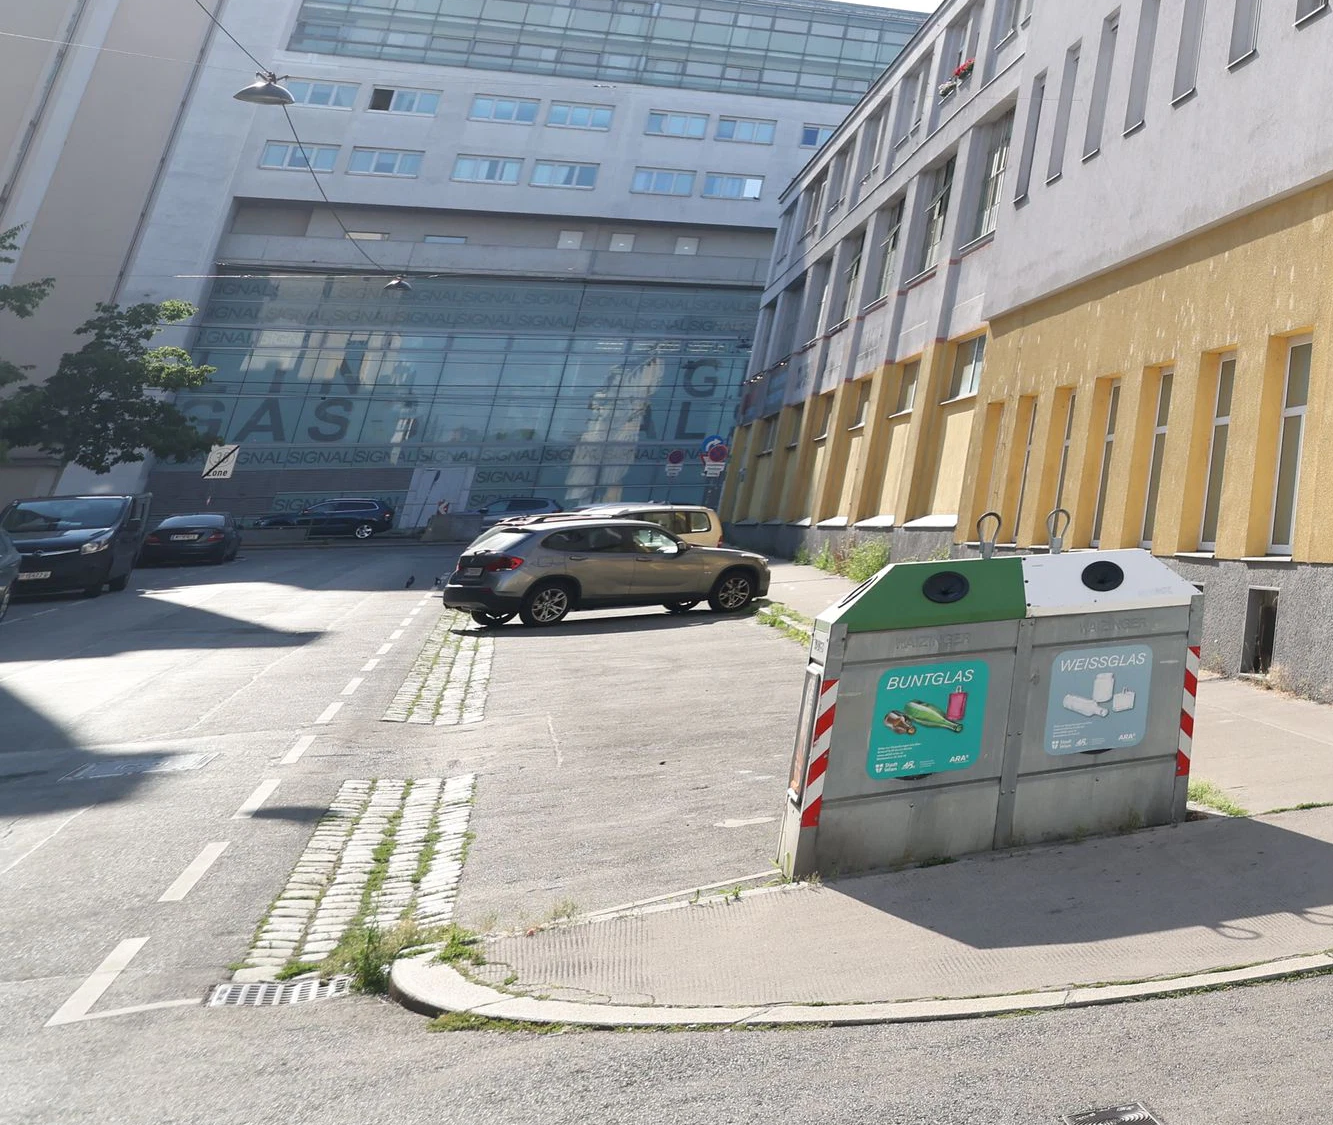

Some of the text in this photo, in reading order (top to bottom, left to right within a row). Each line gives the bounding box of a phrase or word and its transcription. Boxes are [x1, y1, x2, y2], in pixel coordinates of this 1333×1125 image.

[287, 451, 351, 465] SIGNAL
[475, 471, 533, 485] SIGNAL
[1060, 652, 1147, 672] WEISSGLAS
[886, 669, 975, 690] BUNTGLAS
